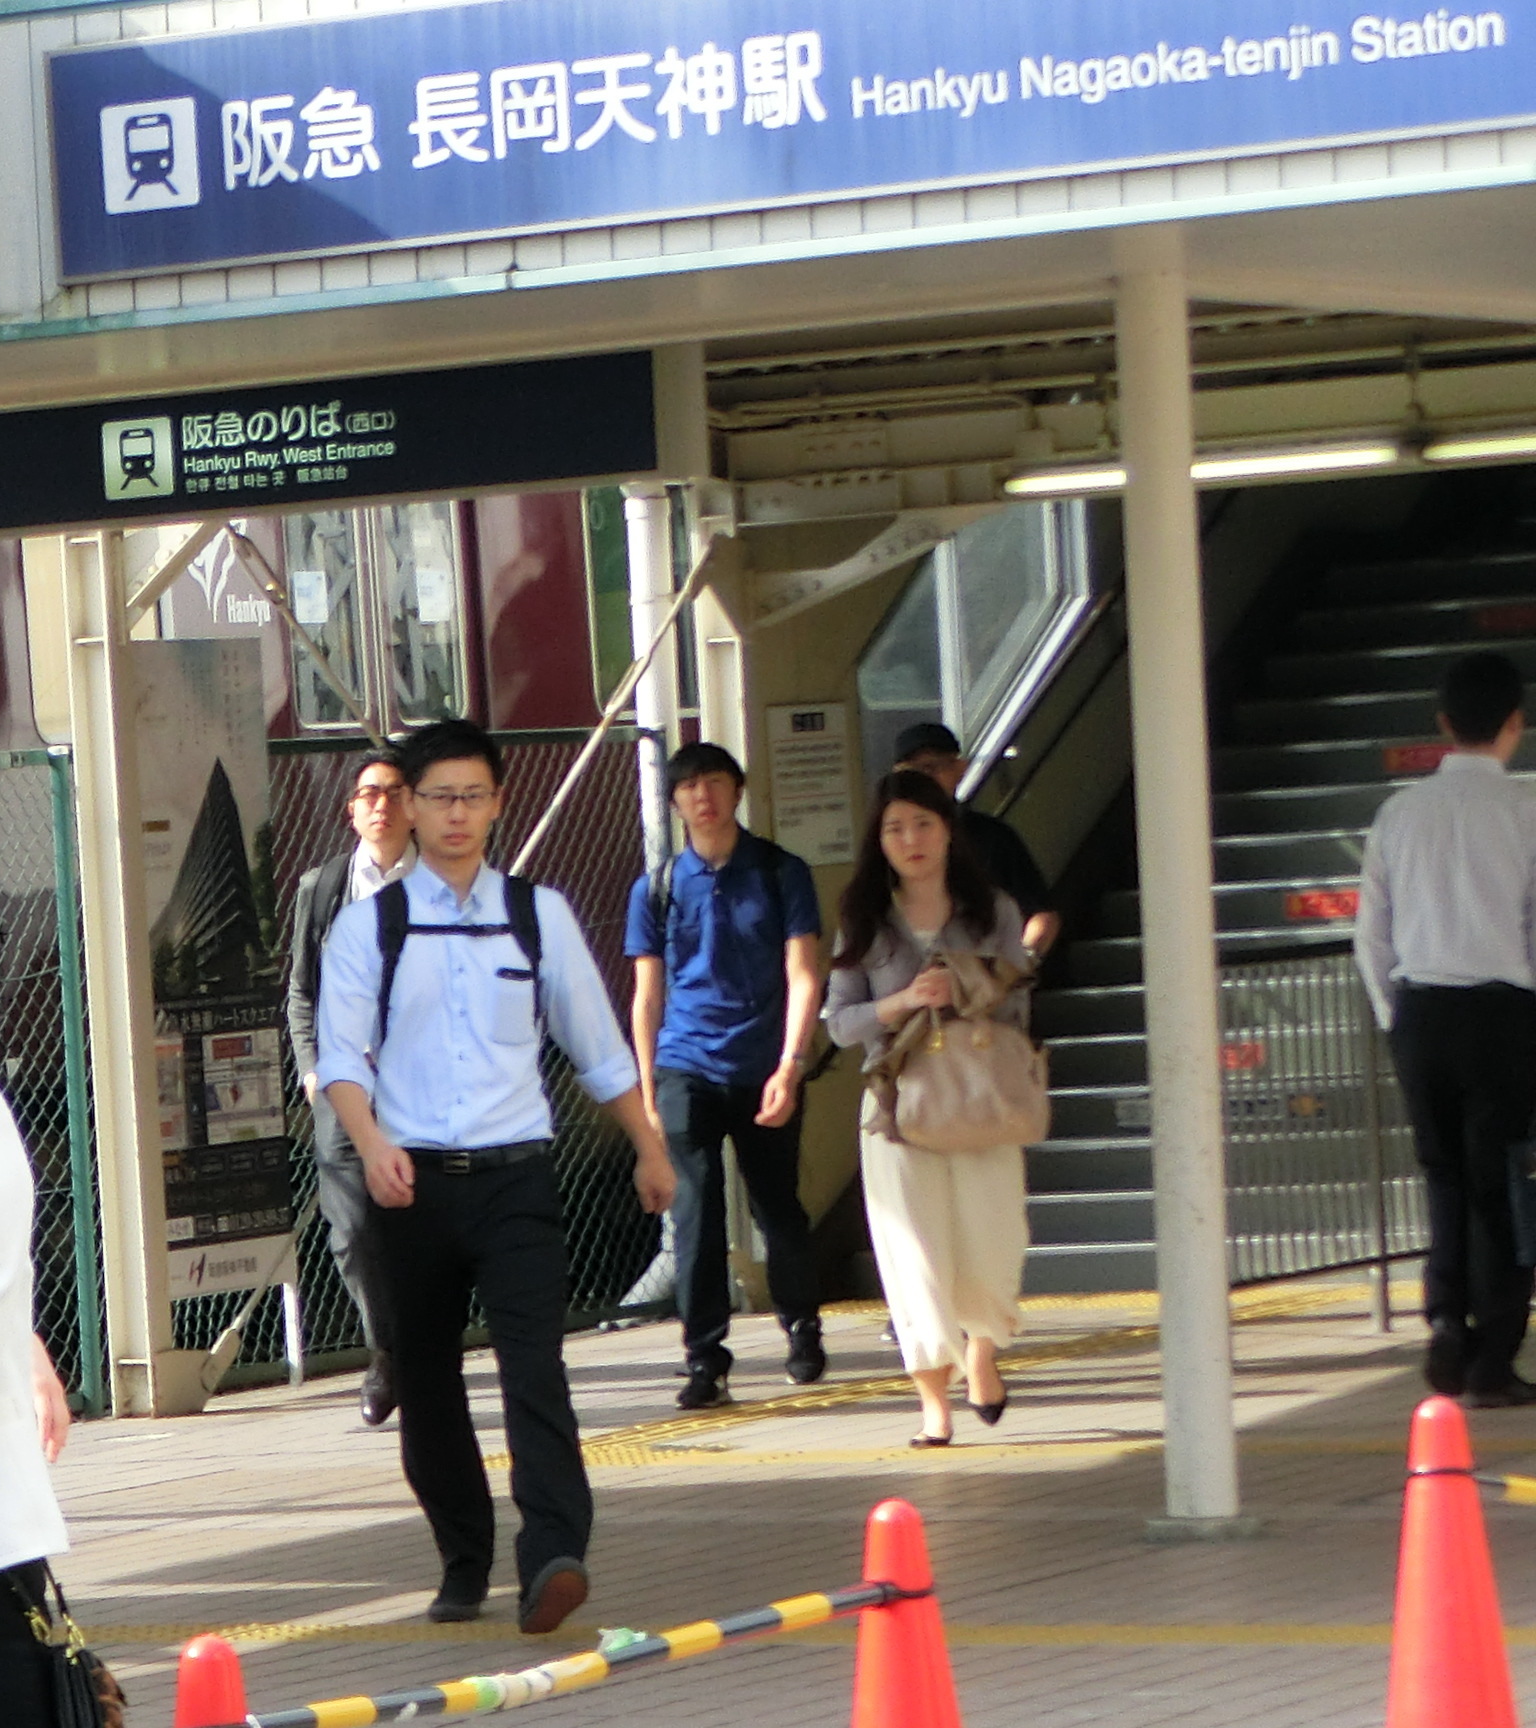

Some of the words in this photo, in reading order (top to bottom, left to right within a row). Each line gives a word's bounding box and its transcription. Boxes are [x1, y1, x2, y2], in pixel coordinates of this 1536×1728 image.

[851, 67, 1008, 119] Hankyu
[1019, 25, 1340, 104] Nagaoka-tenjin
[1350, 7, 1506, 64] Station
[221, 85, 381, 190] 阪急
[408, 30, 827, 170] 長岡天神駅
[183, 454, 242, 474] Hankyu
[245, 450, 280, 470] Rwy.
[283, 446, 323, 465] West
[326, 440, 396, 461] Entrance
[226, 593, 271, 627] Hankyu
